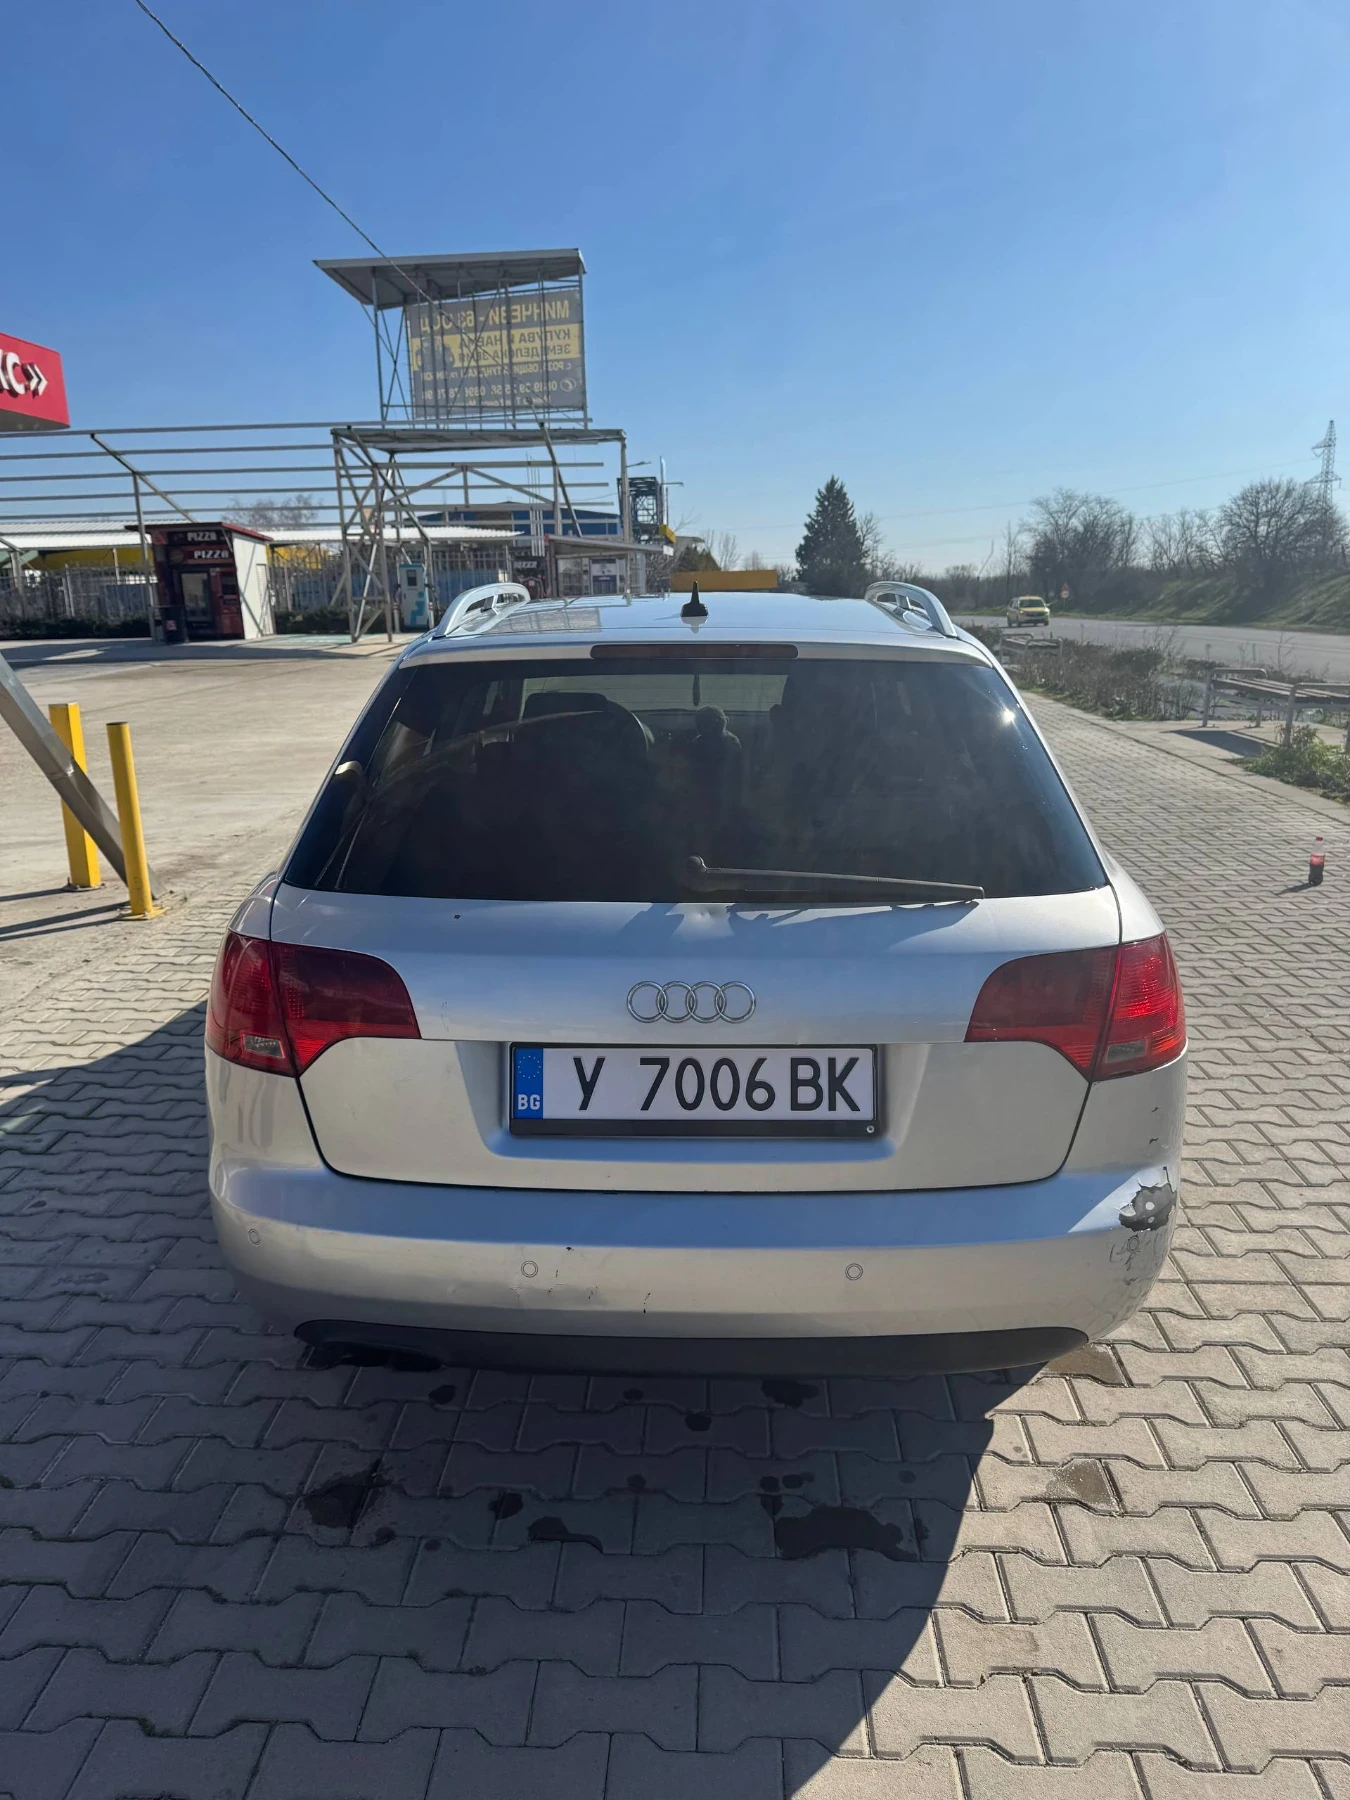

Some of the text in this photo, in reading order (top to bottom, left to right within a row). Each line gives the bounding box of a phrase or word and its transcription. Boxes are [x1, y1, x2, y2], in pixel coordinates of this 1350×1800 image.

[187, 531, 217, 541] PIZZA
[194, 549, 229, 559] PIZZA
[639, 1057, 776, 1111] 7006
[517, 1094, 541, 1110] BG
